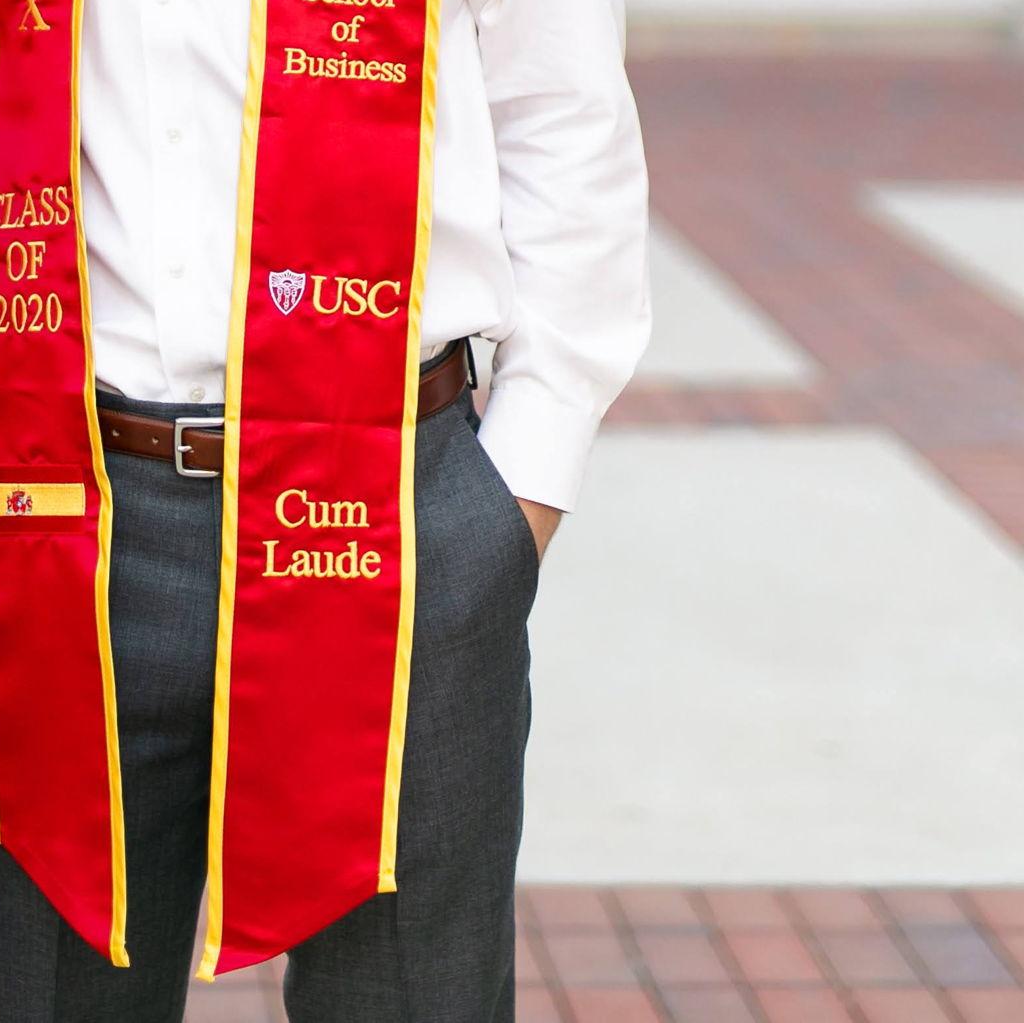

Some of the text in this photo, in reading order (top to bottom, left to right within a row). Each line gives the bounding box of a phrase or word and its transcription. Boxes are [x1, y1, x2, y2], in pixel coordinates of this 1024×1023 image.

[331, 15, 365, 42] of
[283, 48, 406, 83] Business
[6, 240, 46, 282] OF
[311, 275, 401, 319] USC
[275, 489, 370, 528] Cum
[262, 539, 382, 579] Laude
